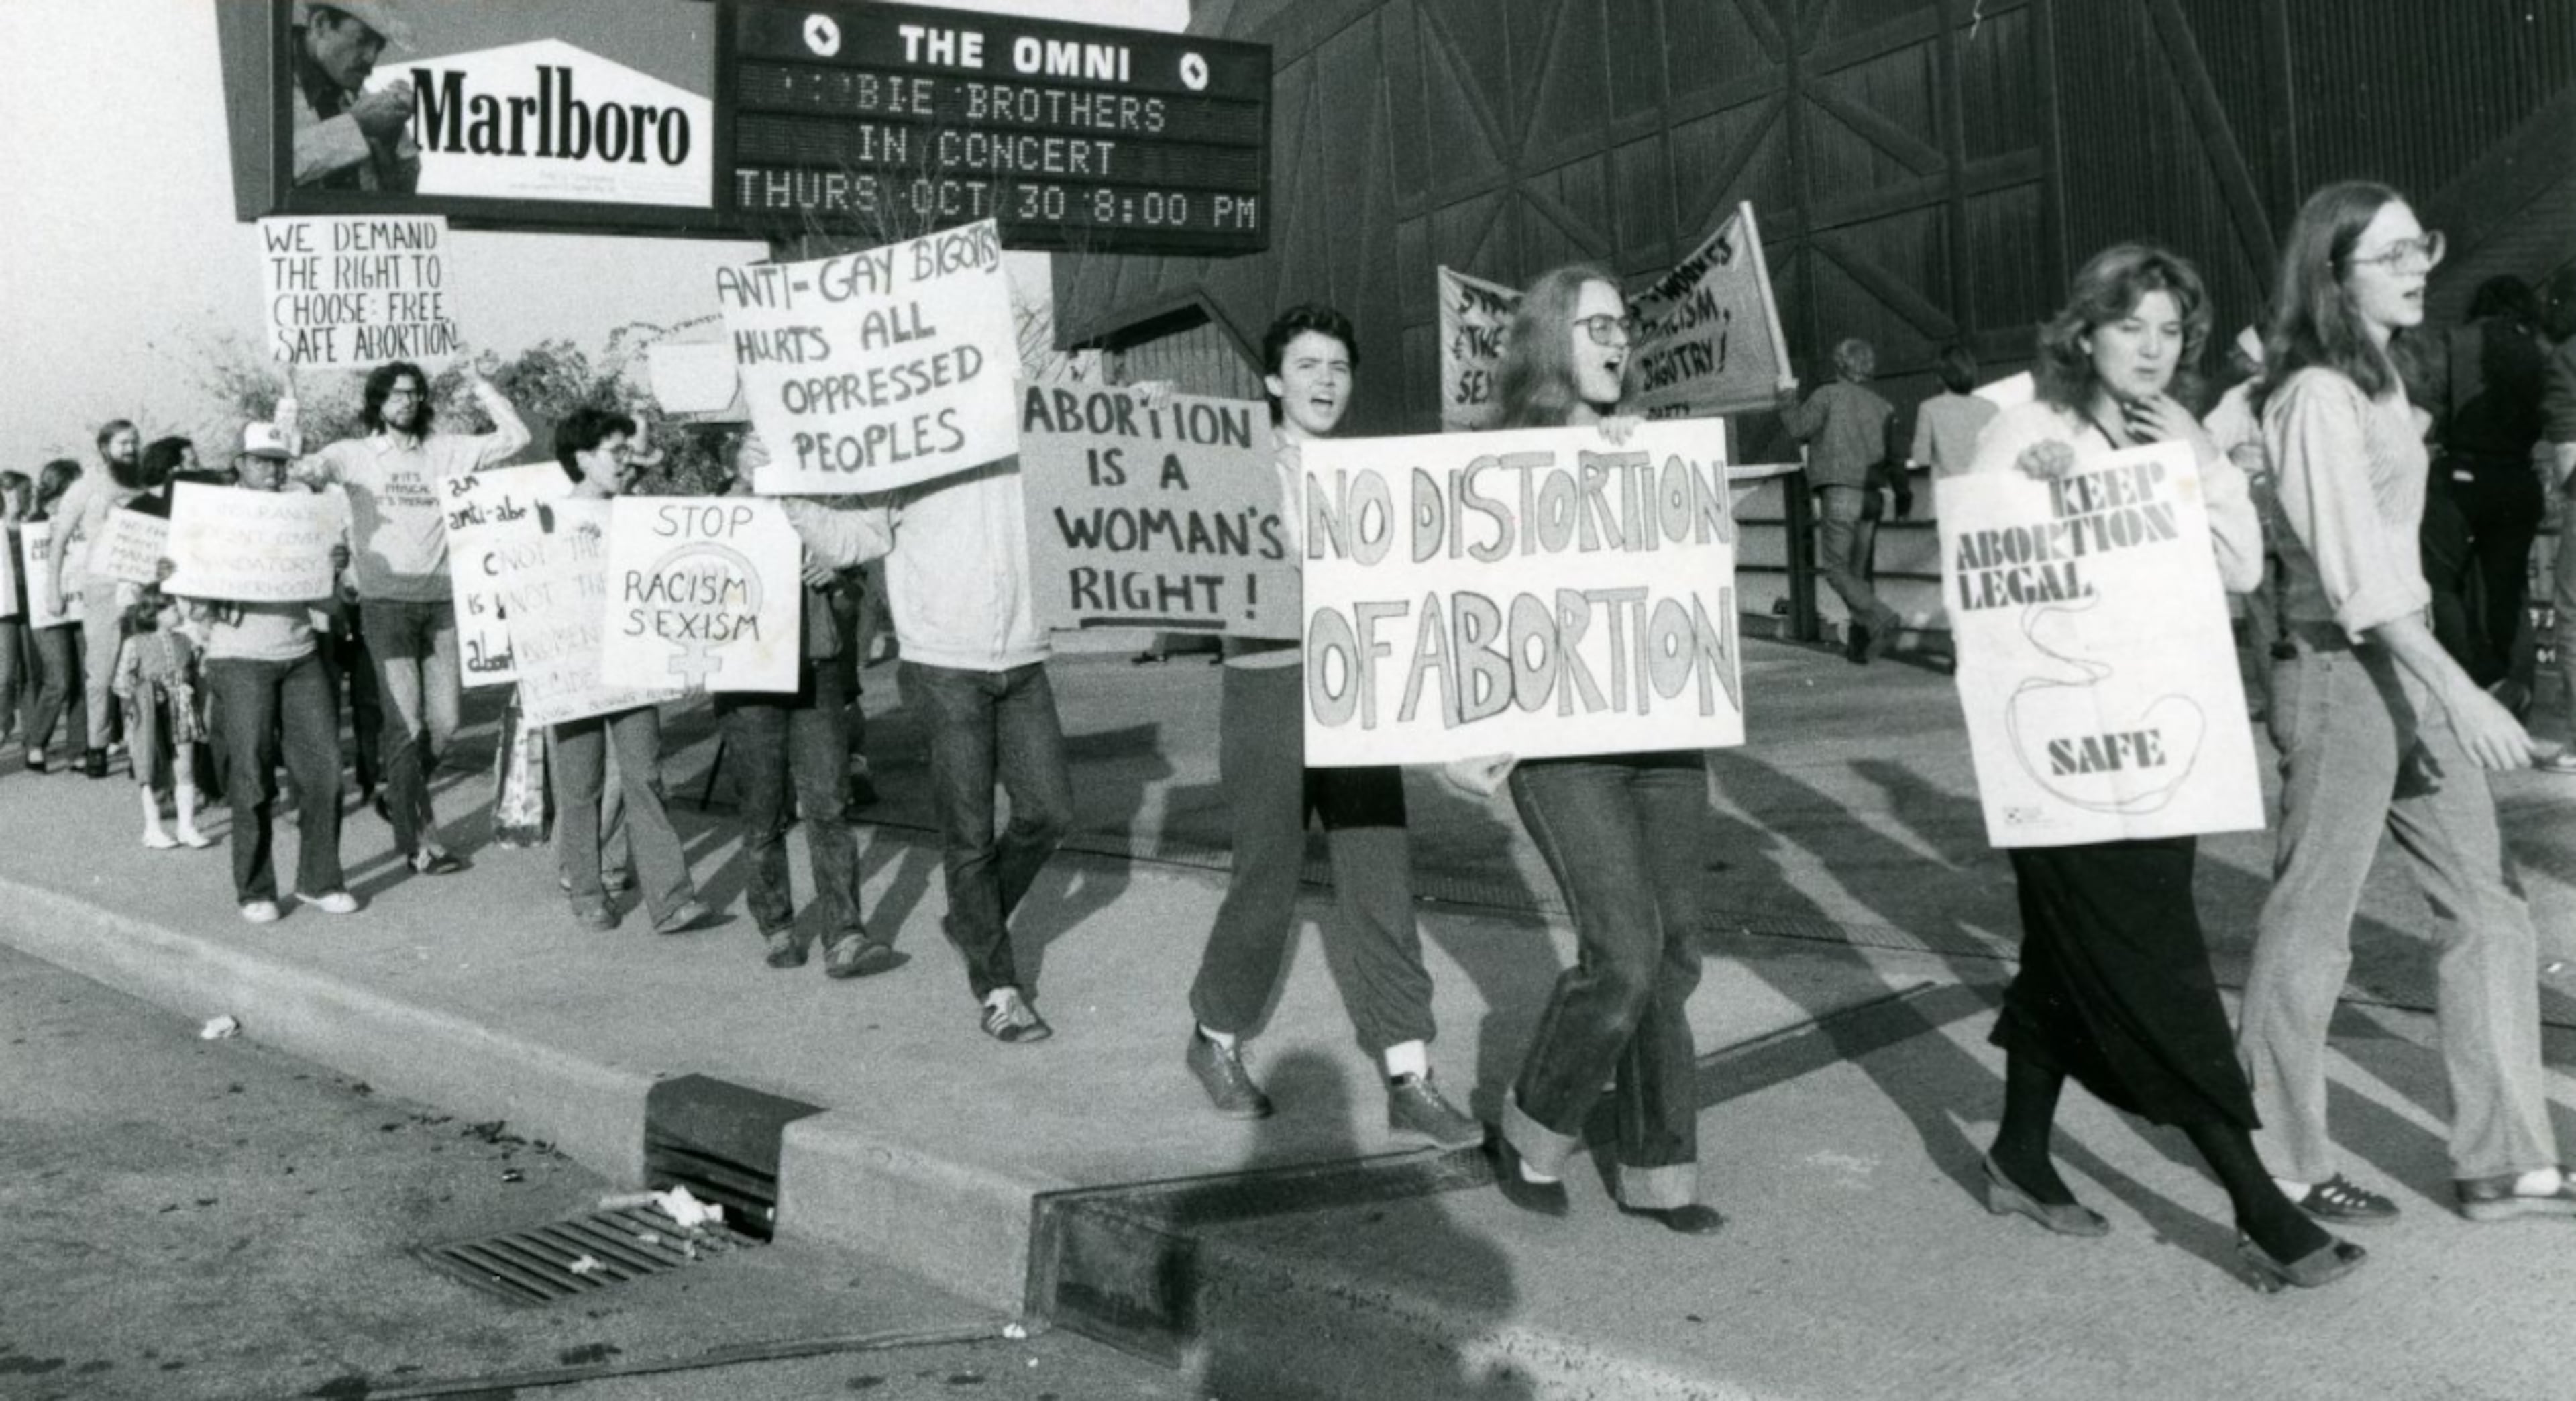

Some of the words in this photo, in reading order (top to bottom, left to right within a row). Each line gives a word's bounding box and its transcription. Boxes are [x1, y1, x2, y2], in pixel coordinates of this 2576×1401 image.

[899, 25, 985, 68] THE
[1013, 38, 1130, 82] OMNI
[410, 65, 690, 167] Marlboro
[967, 83, 1166, 132] BROTHERS
[859, 125, 907, 164] IN
[941, 130, 1116, 176] CONCERT
[736, 169, 878, 212] THURS
[911, 178, 987, 216] OCT
[1018, 185, 1065, 221] 30
[1093, 188, 1187, 225] 8:00
[1214, 195, 1256, 229] PM
[264, 223, 314, 252] WE
[334, 222, 437, 252] DEMAND
[271, 256, 321, 290] THE
[335, 255, 401, 290] RIGHT
[411, 254, 441, 289] TO
[716, 248, 894, 310] ANTI-GAY
[909, 224, 999, 282] BIGOTRY
[273, 326, 337, 364] SAFE
[354, 323, 458, 361] ABORTION
[734, 325, 831, 365] HURTS
[861, 301, 937, 350] ALL
[782, 344, 983, 415] OPPRESSED
[792, 407, 965, 474] PEOPLES
[1024, 385, 1252, 449] ABORTION
[1086, 446, 1126, 486] IS
[1159, 452, 1189, 490] A
[2048, 461, 2166, 518] KEEP
[653, 505, 754, 539] STOP
[1053, 505, 1285, 560] WOMAN'S
[1306, 468, 1395, 567] NO
[1411, 450, 1731, 564] DISTORTION
[1957, 501, 2179, 572] ABORTION
[624, 570, 747, 604] RACISM
[1957, 560, 2094, 611] LEGAL
[623, 609, 760, 641] SEXISM
[1307, 599, 1411, 731] OF
[1396, 586, 1741, 731] ABORTION
[2047, 728, 2167, 776] SAFE
